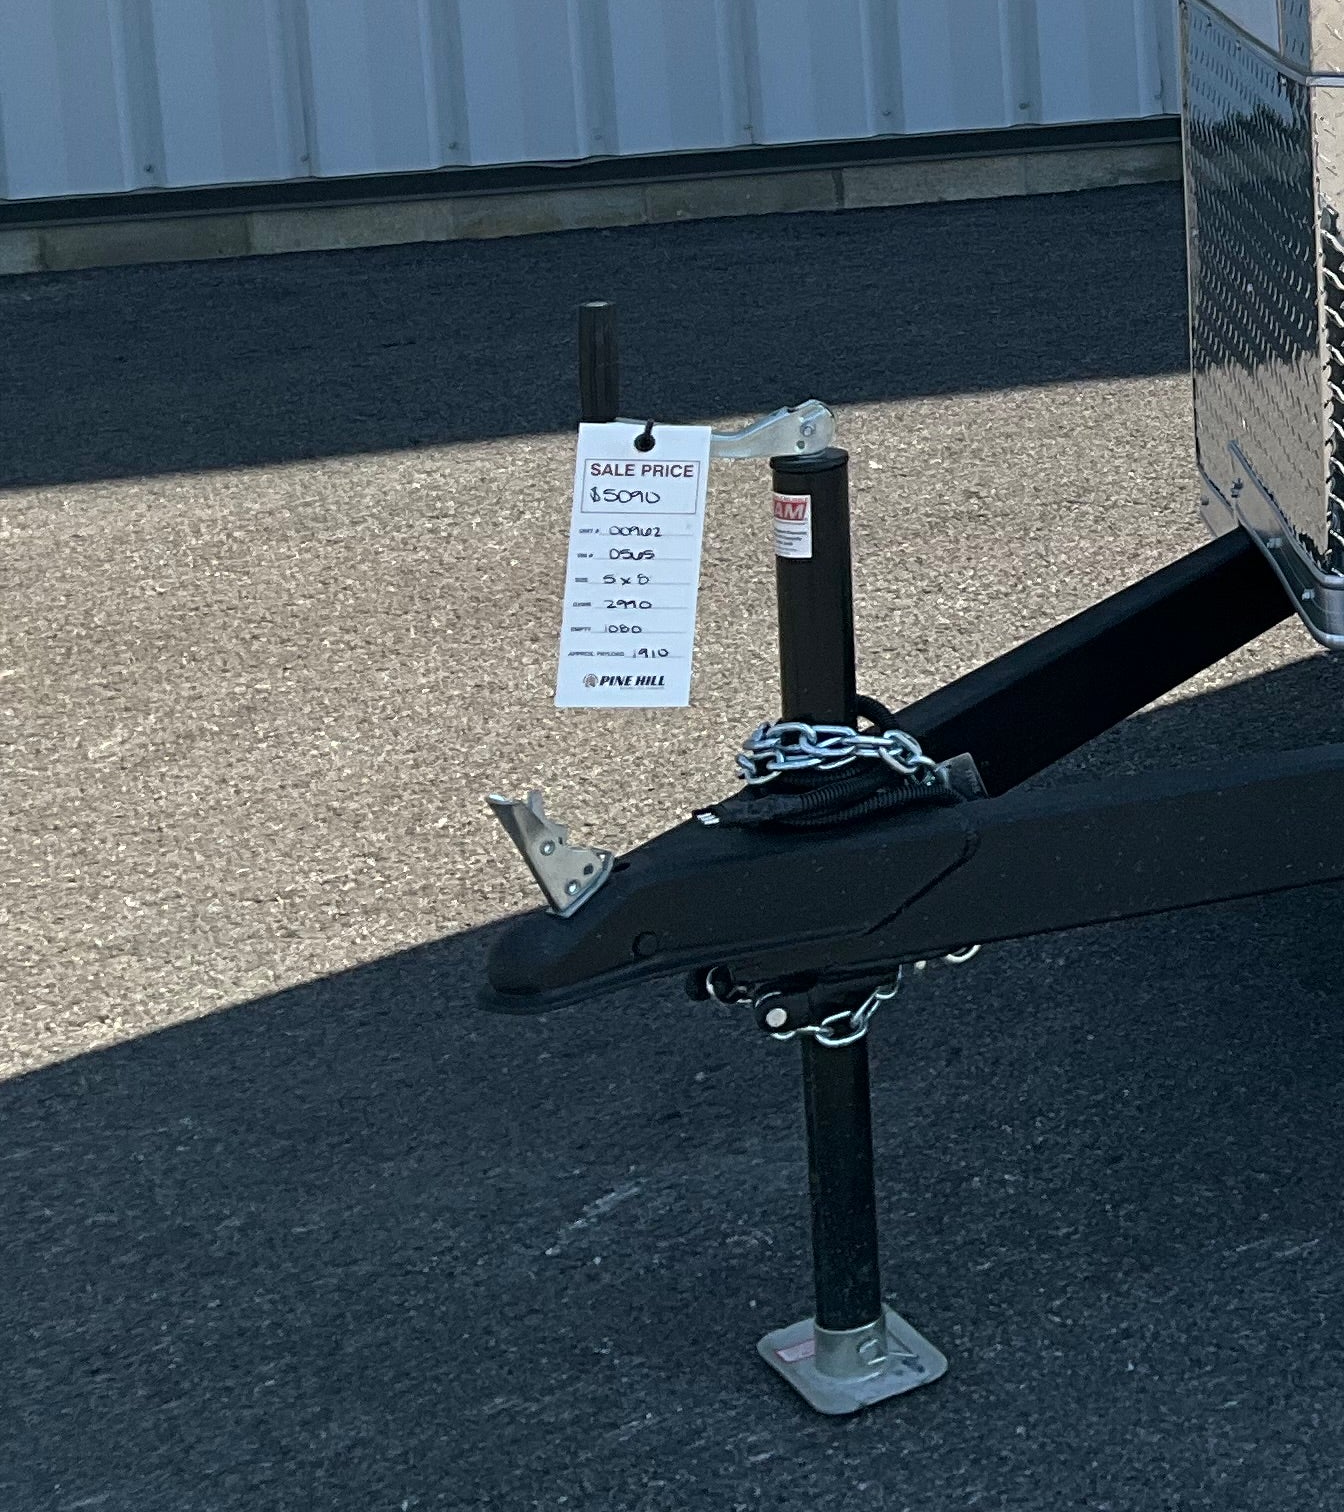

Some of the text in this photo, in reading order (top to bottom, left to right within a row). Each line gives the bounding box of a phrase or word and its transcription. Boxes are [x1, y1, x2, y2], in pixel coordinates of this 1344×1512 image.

[590, 463, 694, 478] SALE PRICE
[590, 486, 661, 504] $5090
[599, 675, 665, 686] PINE HILL
